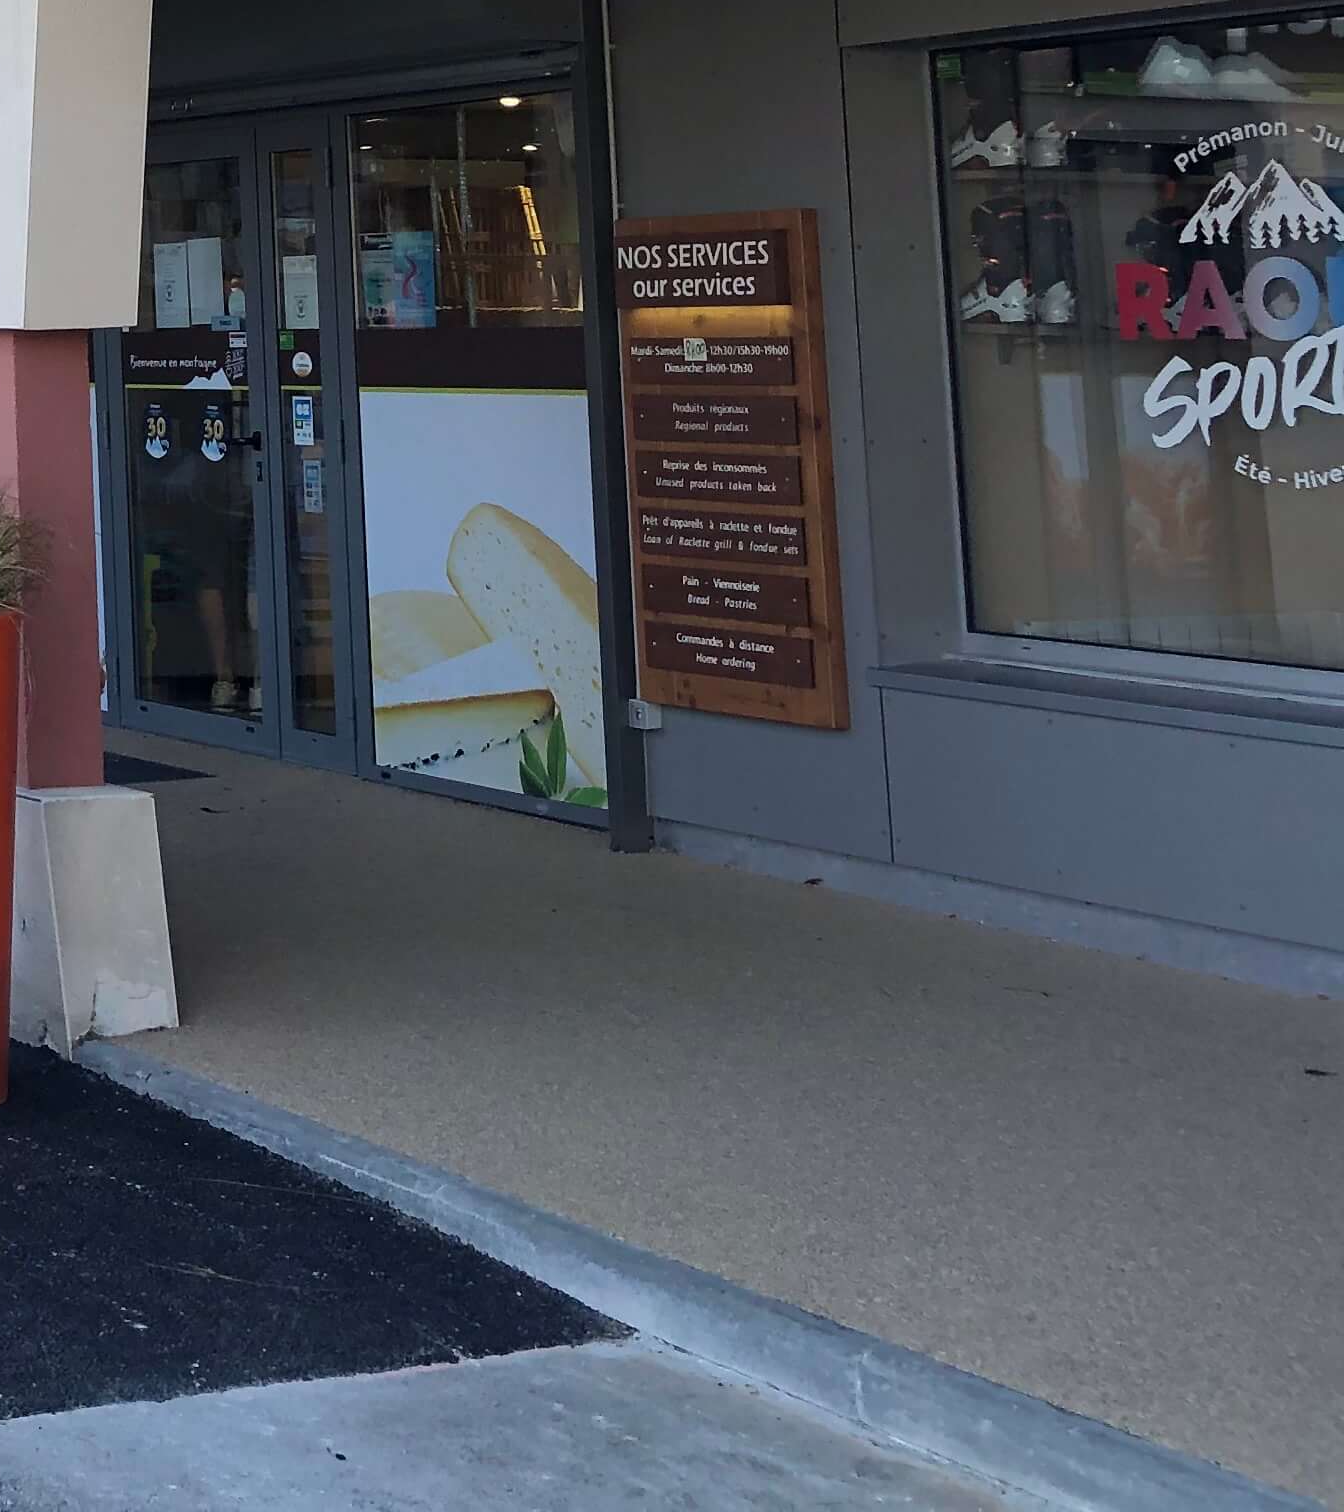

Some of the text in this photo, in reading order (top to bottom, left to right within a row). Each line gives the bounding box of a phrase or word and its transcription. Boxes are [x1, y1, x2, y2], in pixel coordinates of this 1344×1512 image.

[1174, 121, 1287, 173] Prémanon
[617, 240, 769, 269] NOS SERVICES
[633, 272, 756, 298] our services
[1115, 256, 1344, 341] RAO
[130, 354, 167, 369] Bienvenue
[179, 355, 217, 372] montagne
[672, 402, 705, 414] Produits
[146, 417, 167, 438] 30
[203, 418, 224, 439] 30
[674, 420, 749, 433] Regional products
[662, 459, 690, 473] Reprise
[694, 460, 708, 471] des
[1234, 454, 1272, 484] Été
[1294, 465, 1344, 489] Hive
[655, 476, 777, 492] Unused products taken back
[753, 523, 762, 533] et
[768, 523, 798, 536] fondue
[643, 533, 661, 544] Loan
[665, 534, 674, 545] of
[679, 536, 710, 548] Raclette
[714, 540, 732, 551] grill
[749, 541, 777, 553] fondue
[783, 545, 799, 555] sets
[682, 575, 699, 586] Pain
[712, 577, 760, 593] Viennoiserie
[687, 593, 710, 605] Bread
[724, 597, 757, 610] Pastries
[676, 632, 723, 648] Commandes
[739, 639, 775, 654] distance
[696, 652, 756, 672] Home ordering
